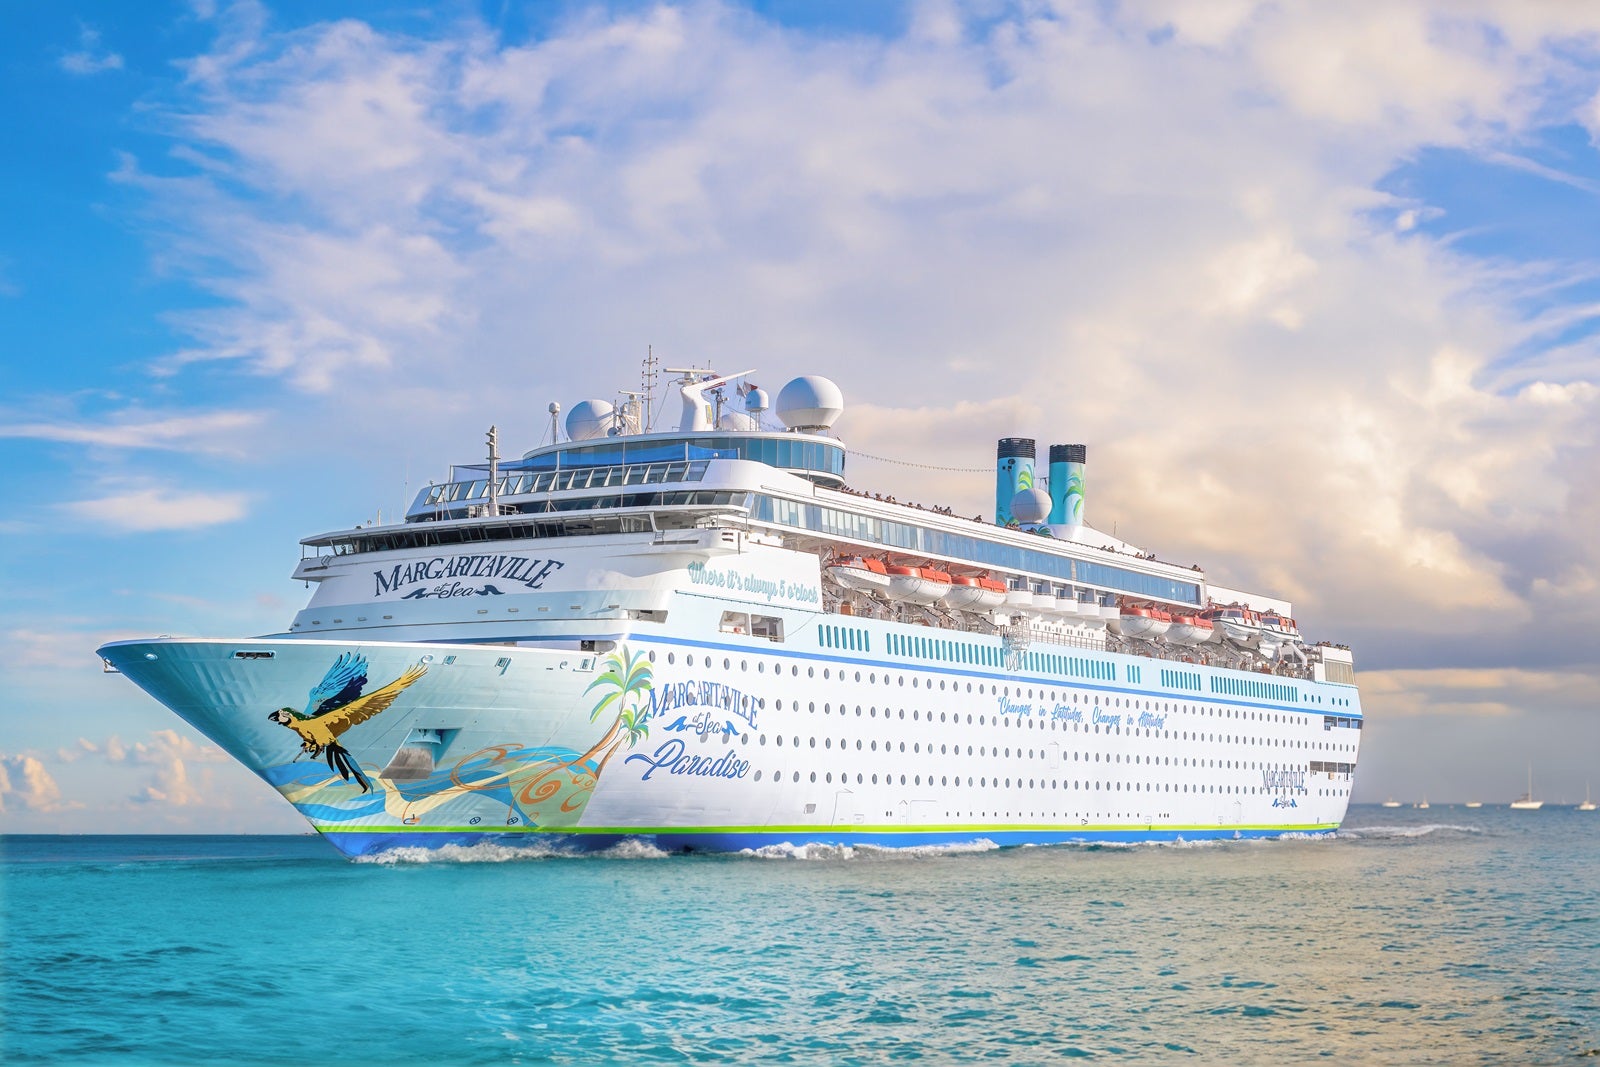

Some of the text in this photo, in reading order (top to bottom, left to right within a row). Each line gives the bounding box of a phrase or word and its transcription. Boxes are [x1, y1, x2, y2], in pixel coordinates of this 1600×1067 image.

[373, 555, 564, 597] MARGARITAVILLE
[438, 582, 476, 599] Sea
[687, 561, 819, 604] Where it's always 5 o'clock
[641, 680, 762, 731] MARGARITAVILLE
[695, 712, 721, 735] Sea
[1038, 705, 1046, 717] in
[1092, 706, 1121, 729] Changes
[1126, 713, 1134, 725] in
[624, 738, 751, 781] Paradise
